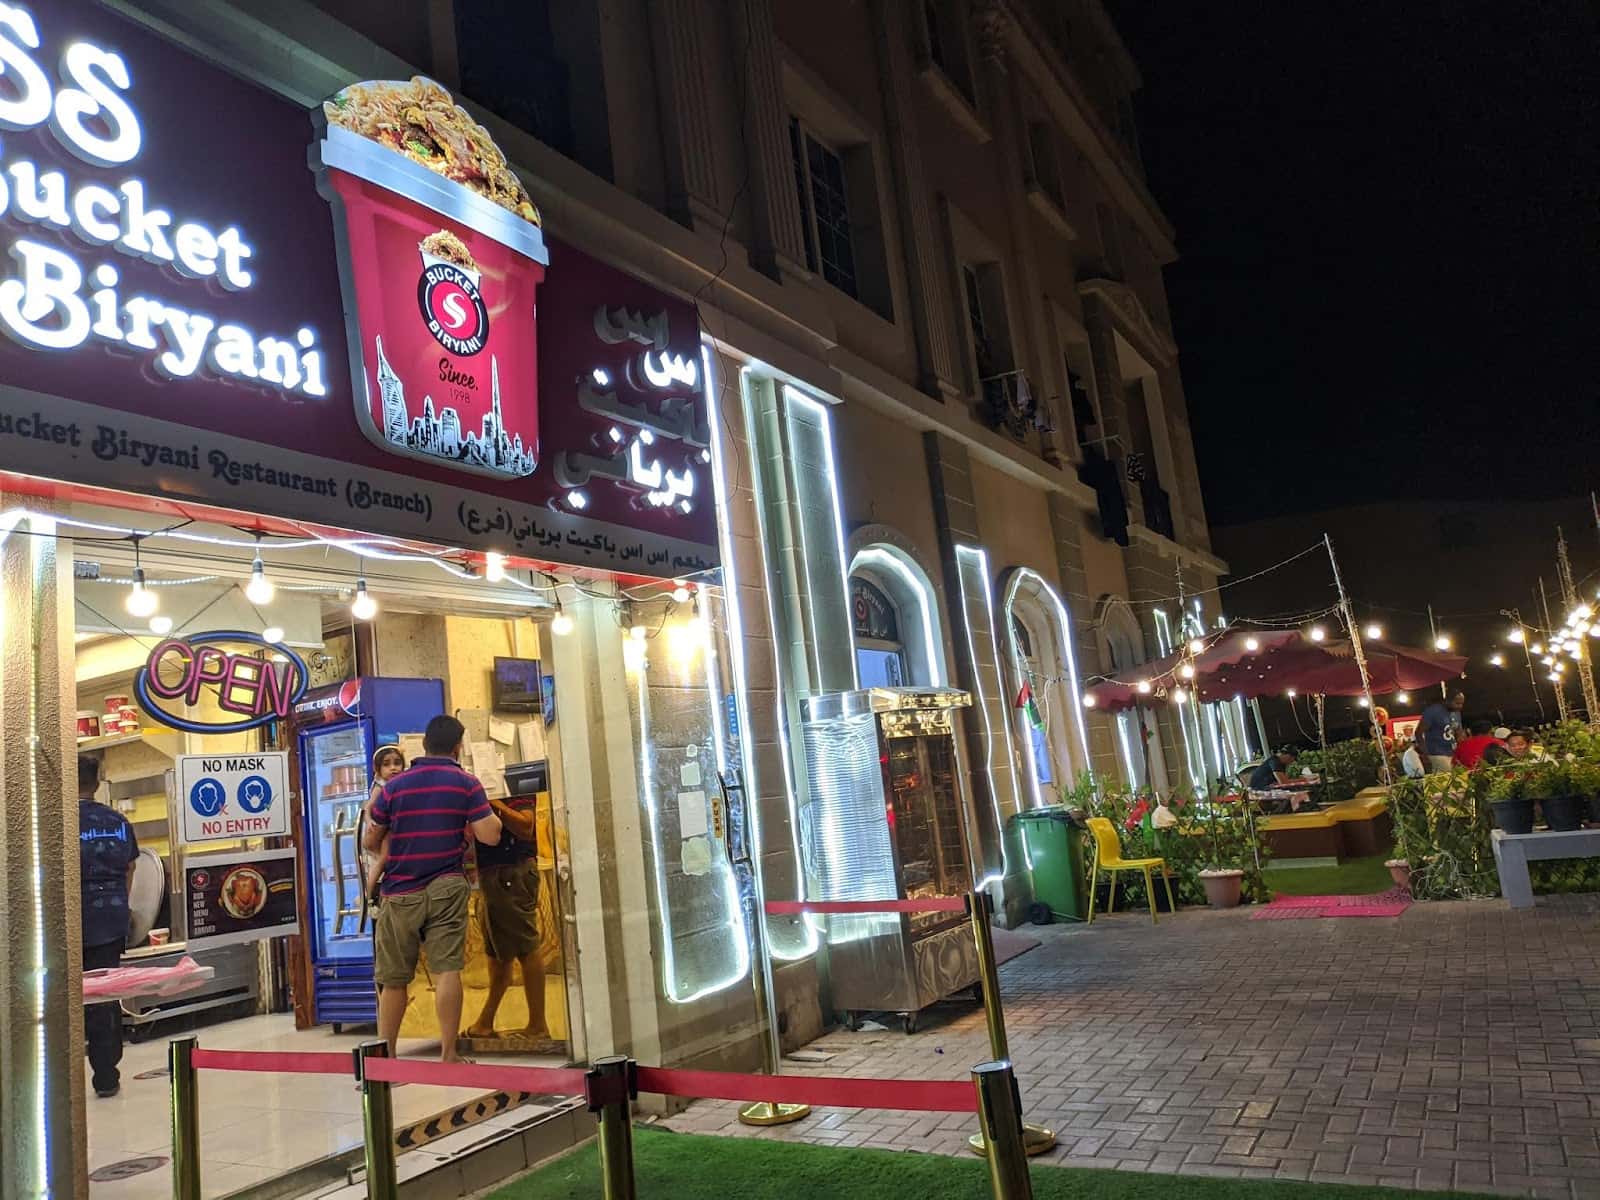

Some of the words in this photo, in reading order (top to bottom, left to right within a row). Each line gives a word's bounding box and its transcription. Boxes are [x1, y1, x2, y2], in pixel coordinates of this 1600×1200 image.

[0, 161, 251, 289] ucket
[426, 267, 480, 300] BUCKET
[0, 240, 327, 396] Biryani
[428, 319, 481, 354] BIRYANI
[438, 357, 479, 391] Since.
[92, 424, 200, 467] Biryani
[208, 449, 338, 498] Restaurant
[345, 479, 433, 522] (Branch)
[566, 530, 616, 559] باكيت
[620, 543, 643, 559] اس
[647, 548, 668, 565] اس
[148, 638, 295, 717] OPEN
[202, 760, 221, 773] NO
[226, 758, 265, 772] MASK
[202, 821, 221, 835] NO
[226, 817, 270, 833] ENTRY
